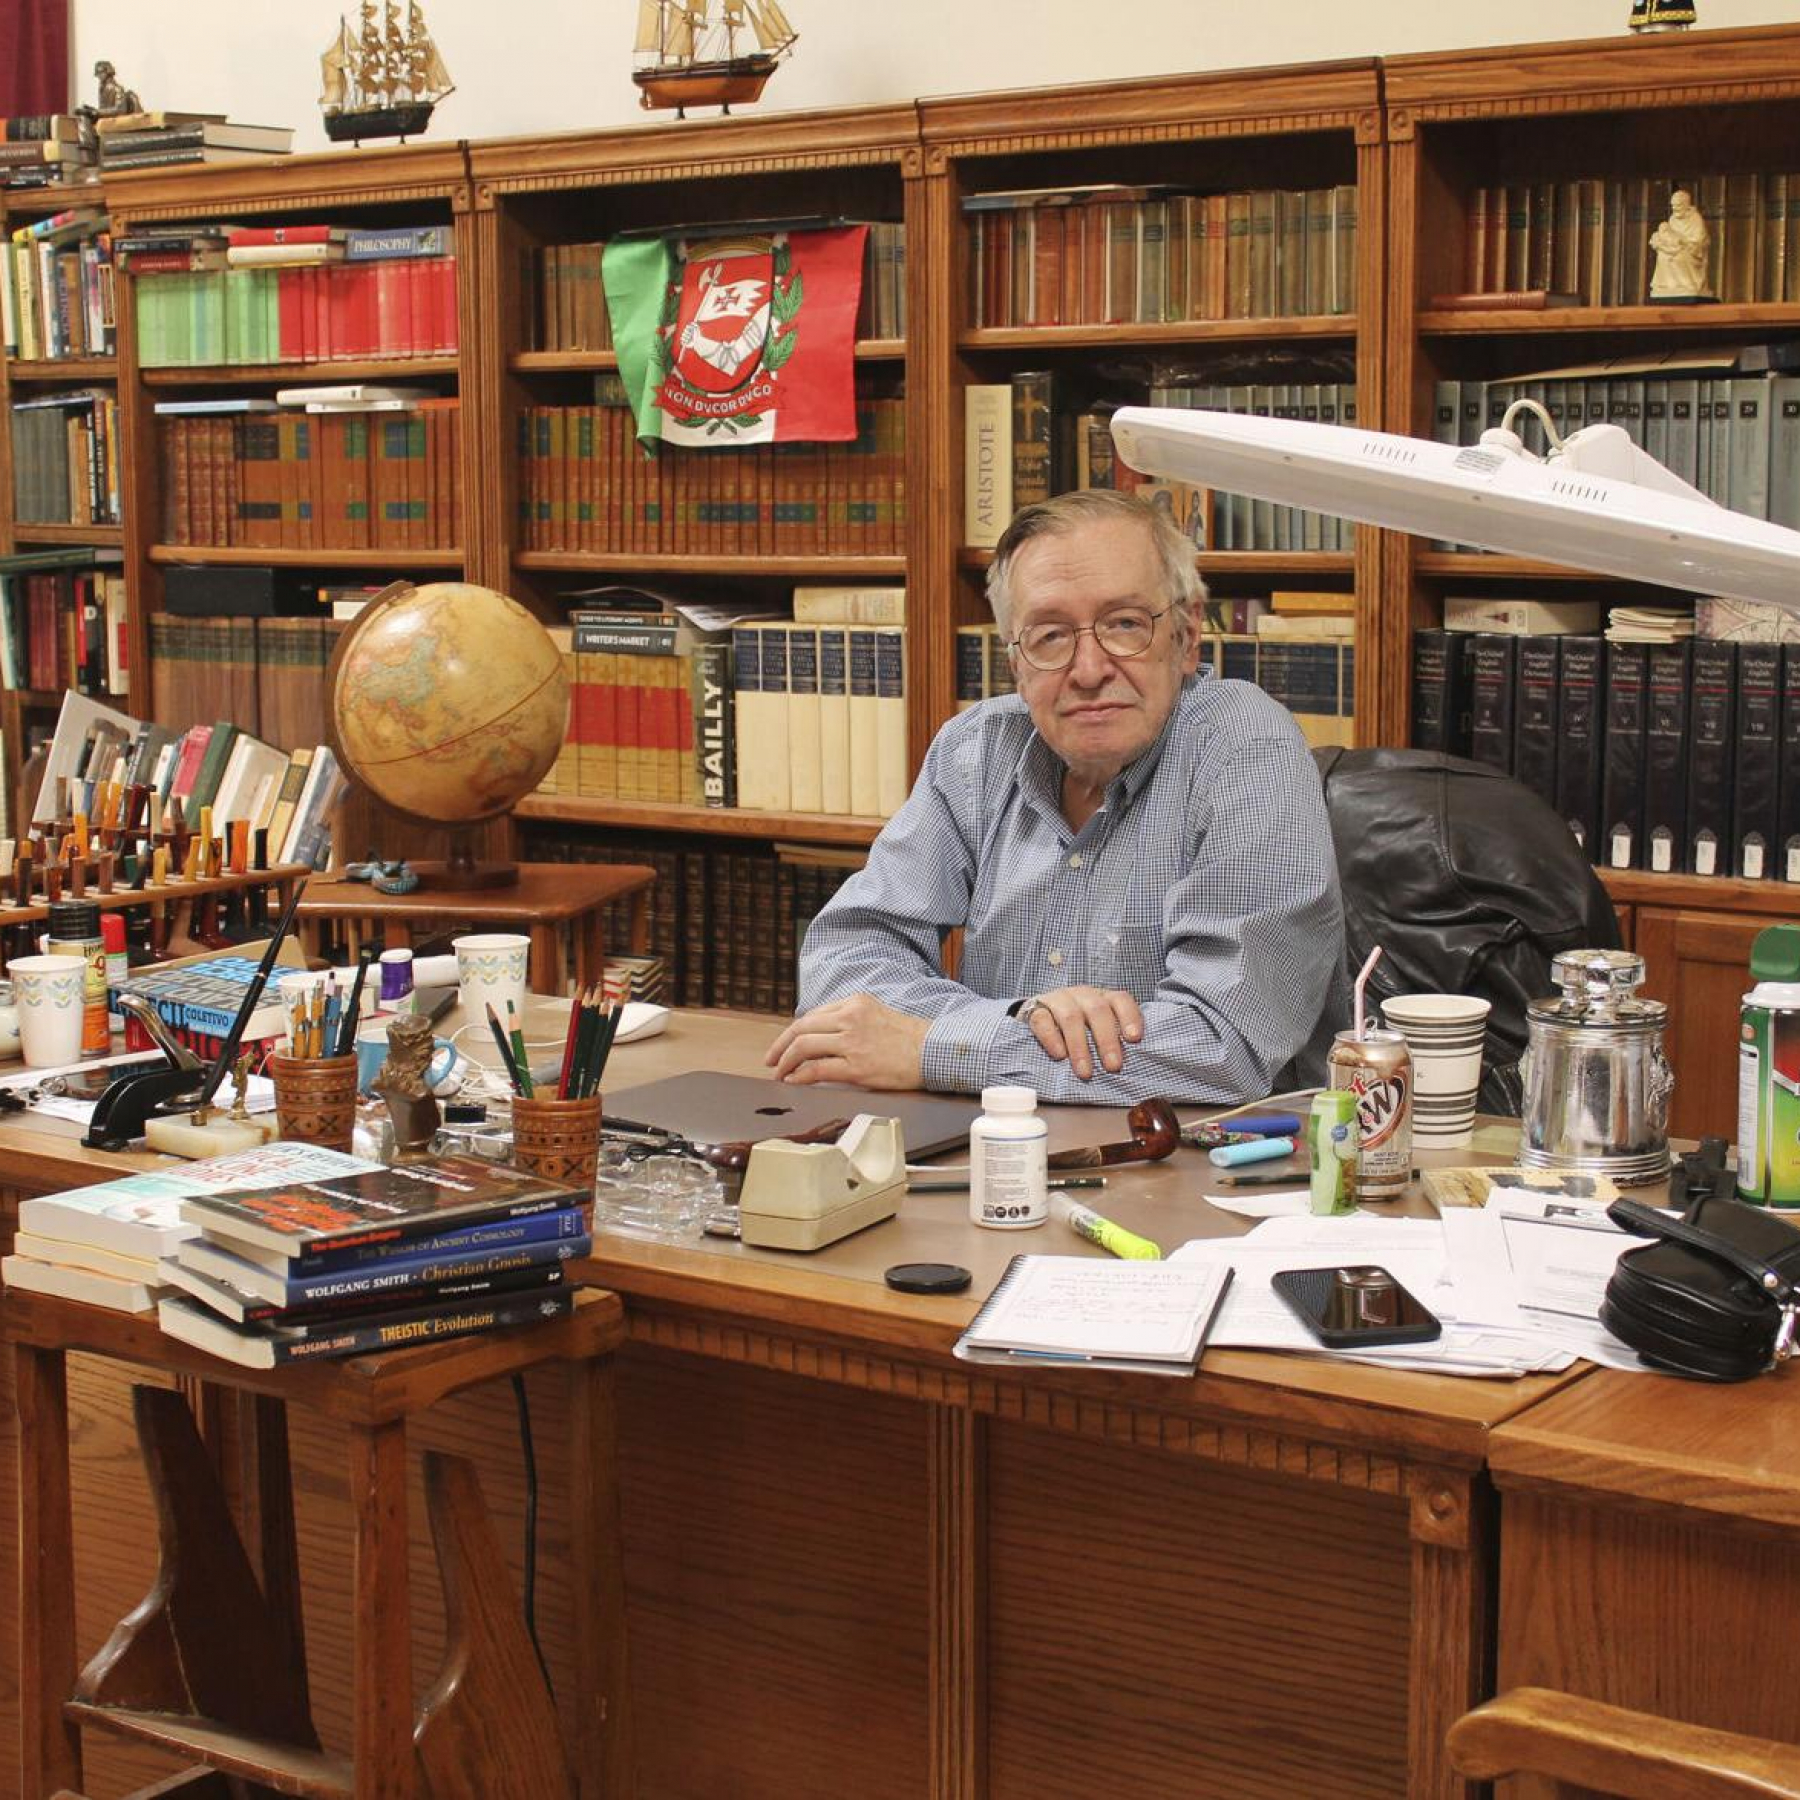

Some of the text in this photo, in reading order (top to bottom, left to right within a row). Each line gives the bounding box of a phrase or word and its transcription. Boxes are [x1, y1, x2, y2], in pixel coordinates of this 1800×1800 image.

[353, 235, 412, 253] PHILOSOPHY
[977, 422, 995, 527] ARISTOTE
[619, 636, 650, 646] MARKET
[704, 679, 723, 797] BAILLY
[185, 1007, 229, 1027] COLETIVO
[305, 1252, 533, 1299] WOLFGANG SMITH Christian Gnosis
[289, 1312, 494, 1356] WOLFGANG SMITH THEISTIC Evolution
